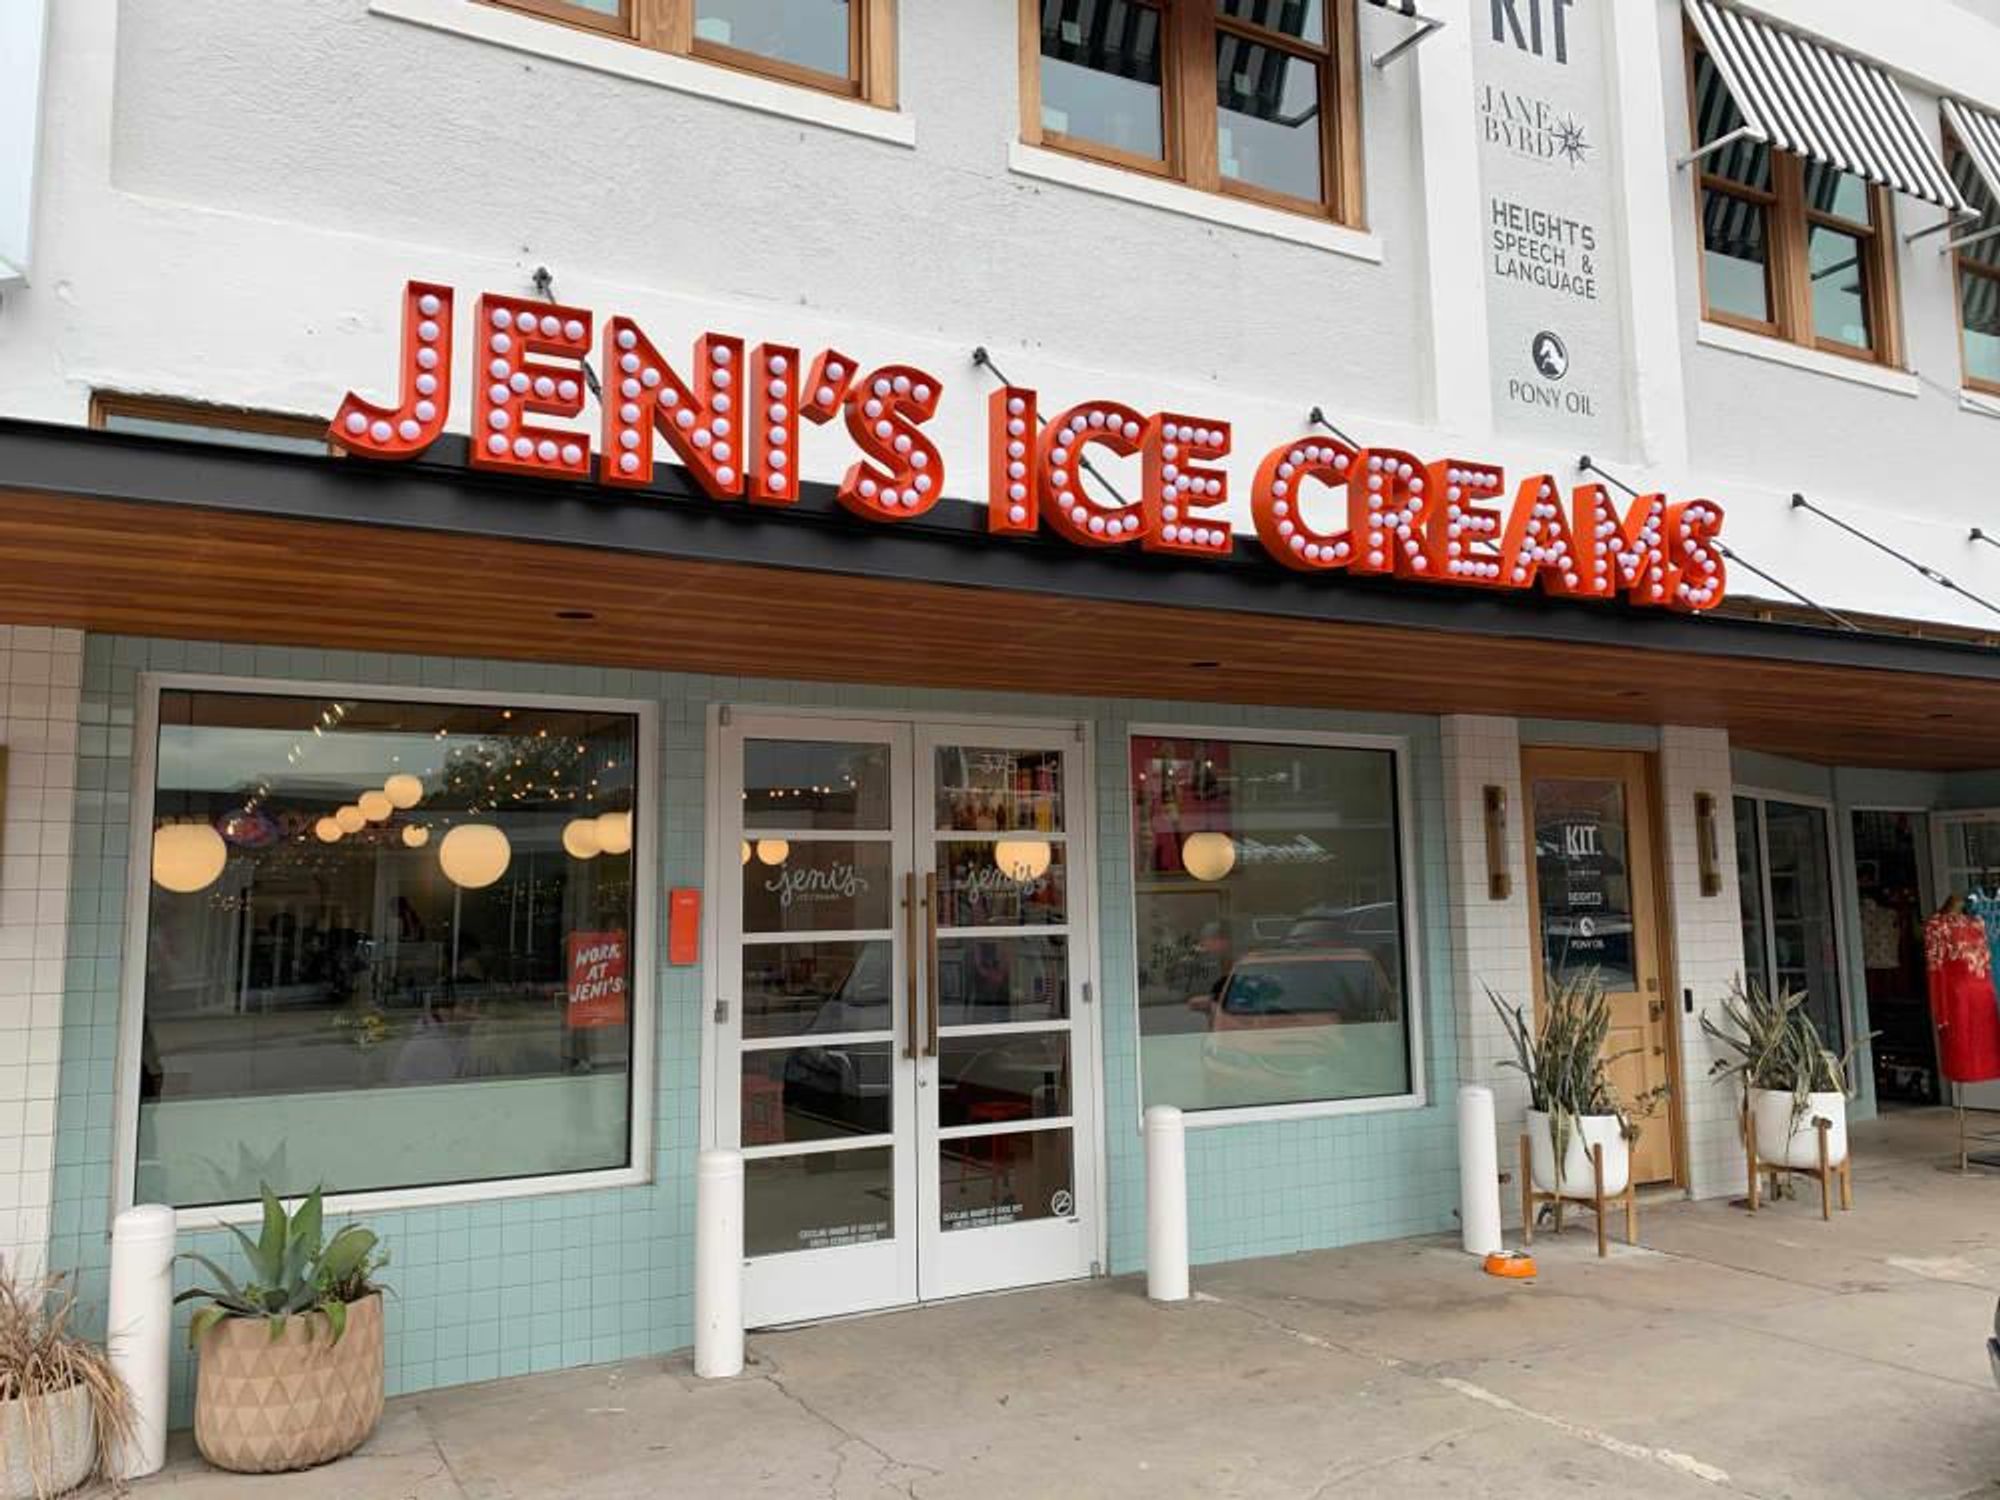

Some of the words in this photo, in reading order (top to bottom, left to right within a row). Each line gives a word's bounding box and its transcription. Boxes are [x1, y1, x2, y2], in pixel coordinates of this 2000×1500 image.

[1481, 84, 1554, 132] JANE
[1484, 116, 1555, 159] BYRD
[1491, 197, 1596, 251] HEIGHTS
[1493, 229, 1566, 268] SPEECH
[1581, 254, 1594, 276] &
[1494, 254, 1597, 300] LANGUAGE
[1508, 378, 1562, 409] PONY
[1565, 391, 1596, 417] OIL
[329, 281, 942, 519] JENI'S
[989, 386, 1232, 554] ICE
[1252, 437, 1725, 610] CREAMS
[765, 861, 869, 906] jeni's
[575, 943, 622, 968] WORK
[586, 961, 608, 981] AT
